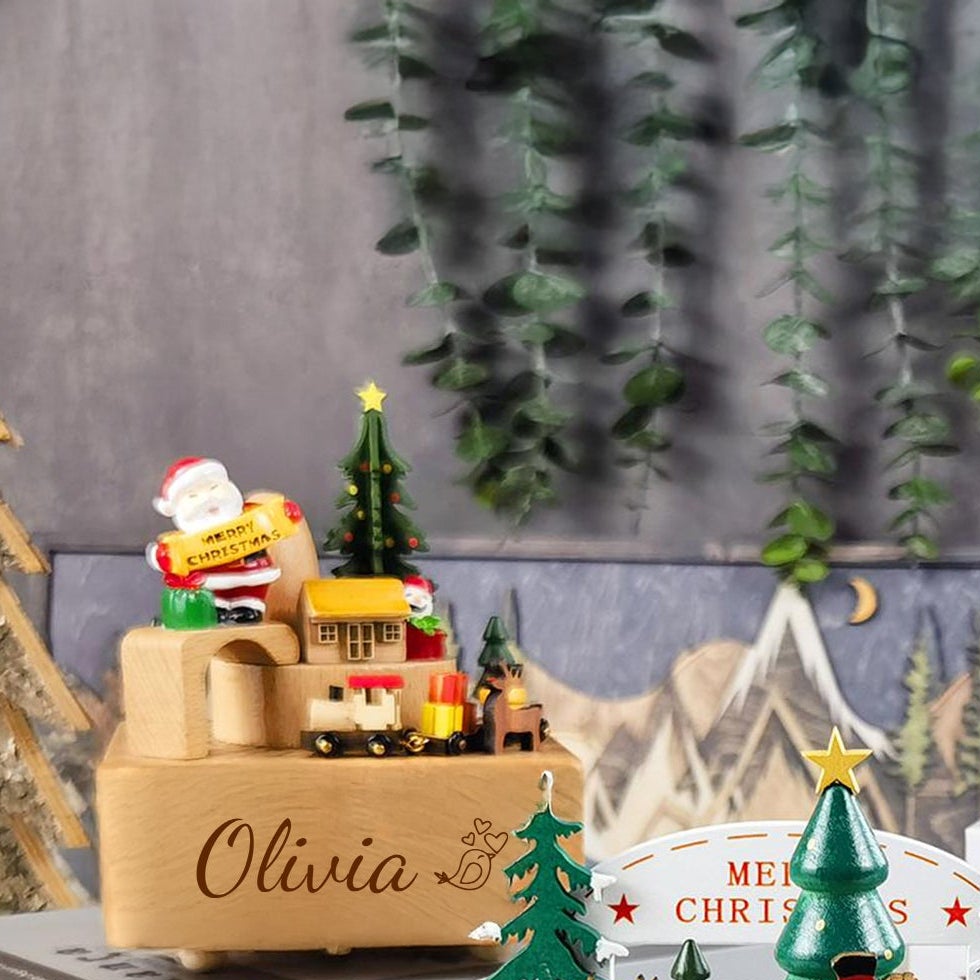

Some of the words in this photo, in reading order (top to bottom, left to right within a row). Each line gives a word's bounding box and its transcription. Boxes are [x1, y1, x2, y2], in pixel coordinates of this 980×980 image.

[186, 529, 281, 566] CHRISTMAS
[202, 520, 254, 545] MERRY
[196, 818, 419, 898] Olivia
